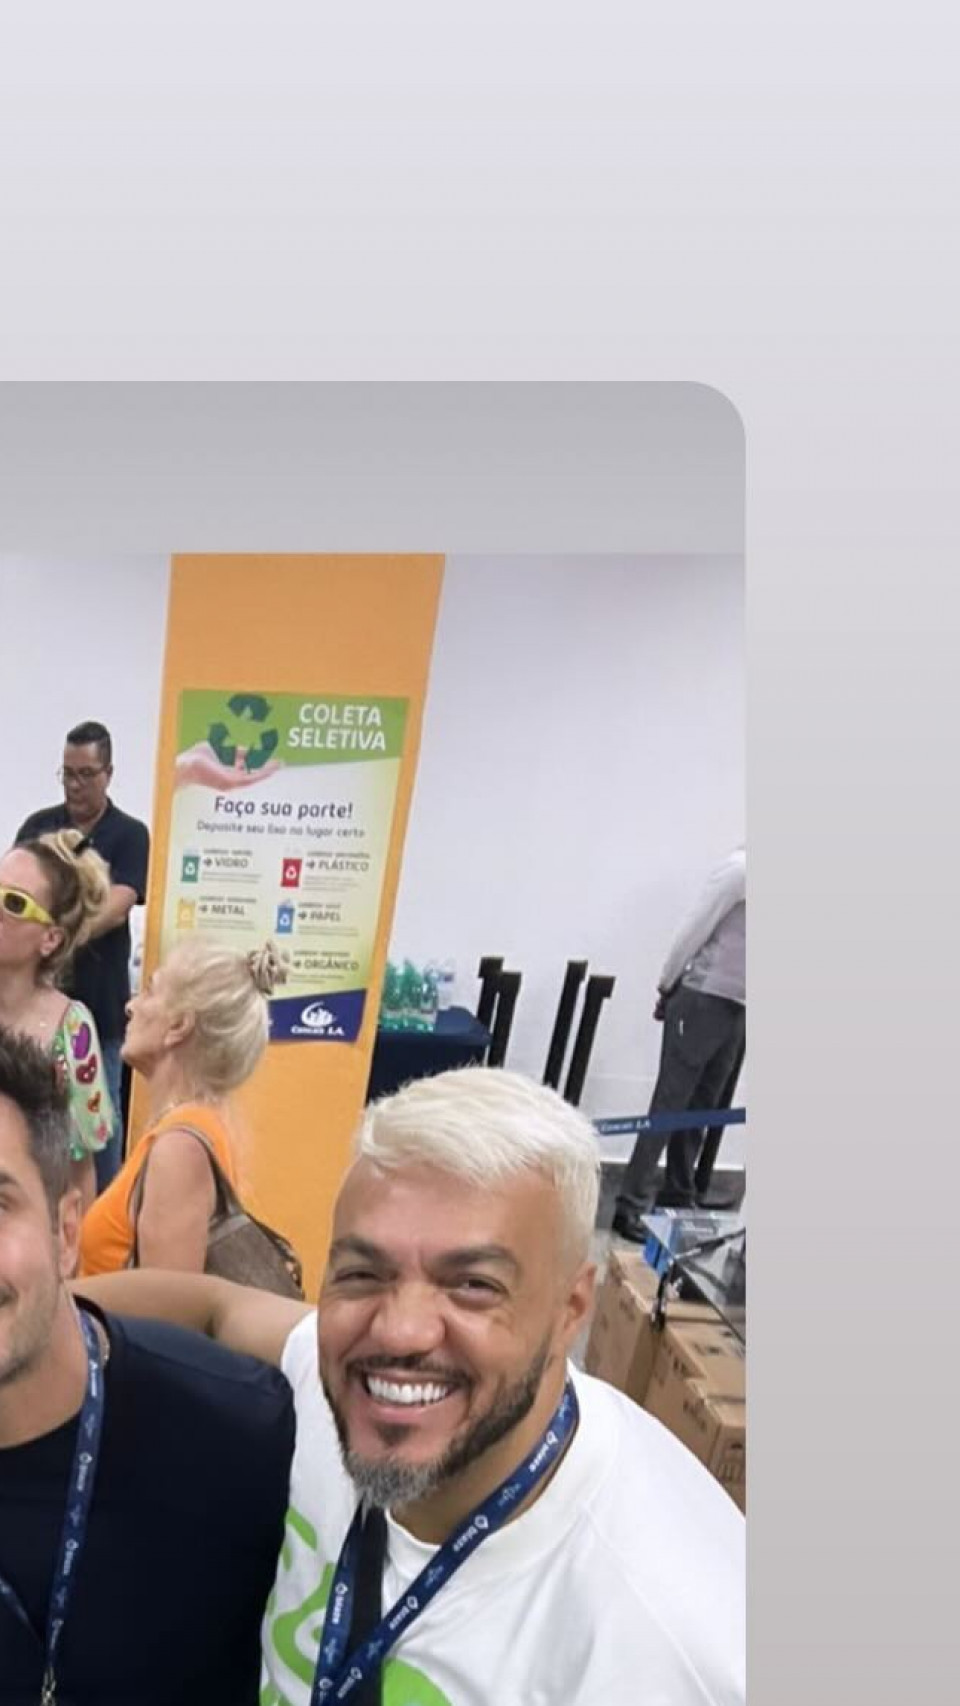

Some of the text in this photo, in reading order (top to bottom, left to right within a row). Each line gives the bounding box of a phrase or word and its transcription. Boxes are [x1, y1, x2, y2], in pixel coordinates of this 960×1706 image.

[299, 703, 382, 726] COLETA
[287, 727, 386, 751] SELETIVA
[214, 796, 354, 820] Faça sua parte!
